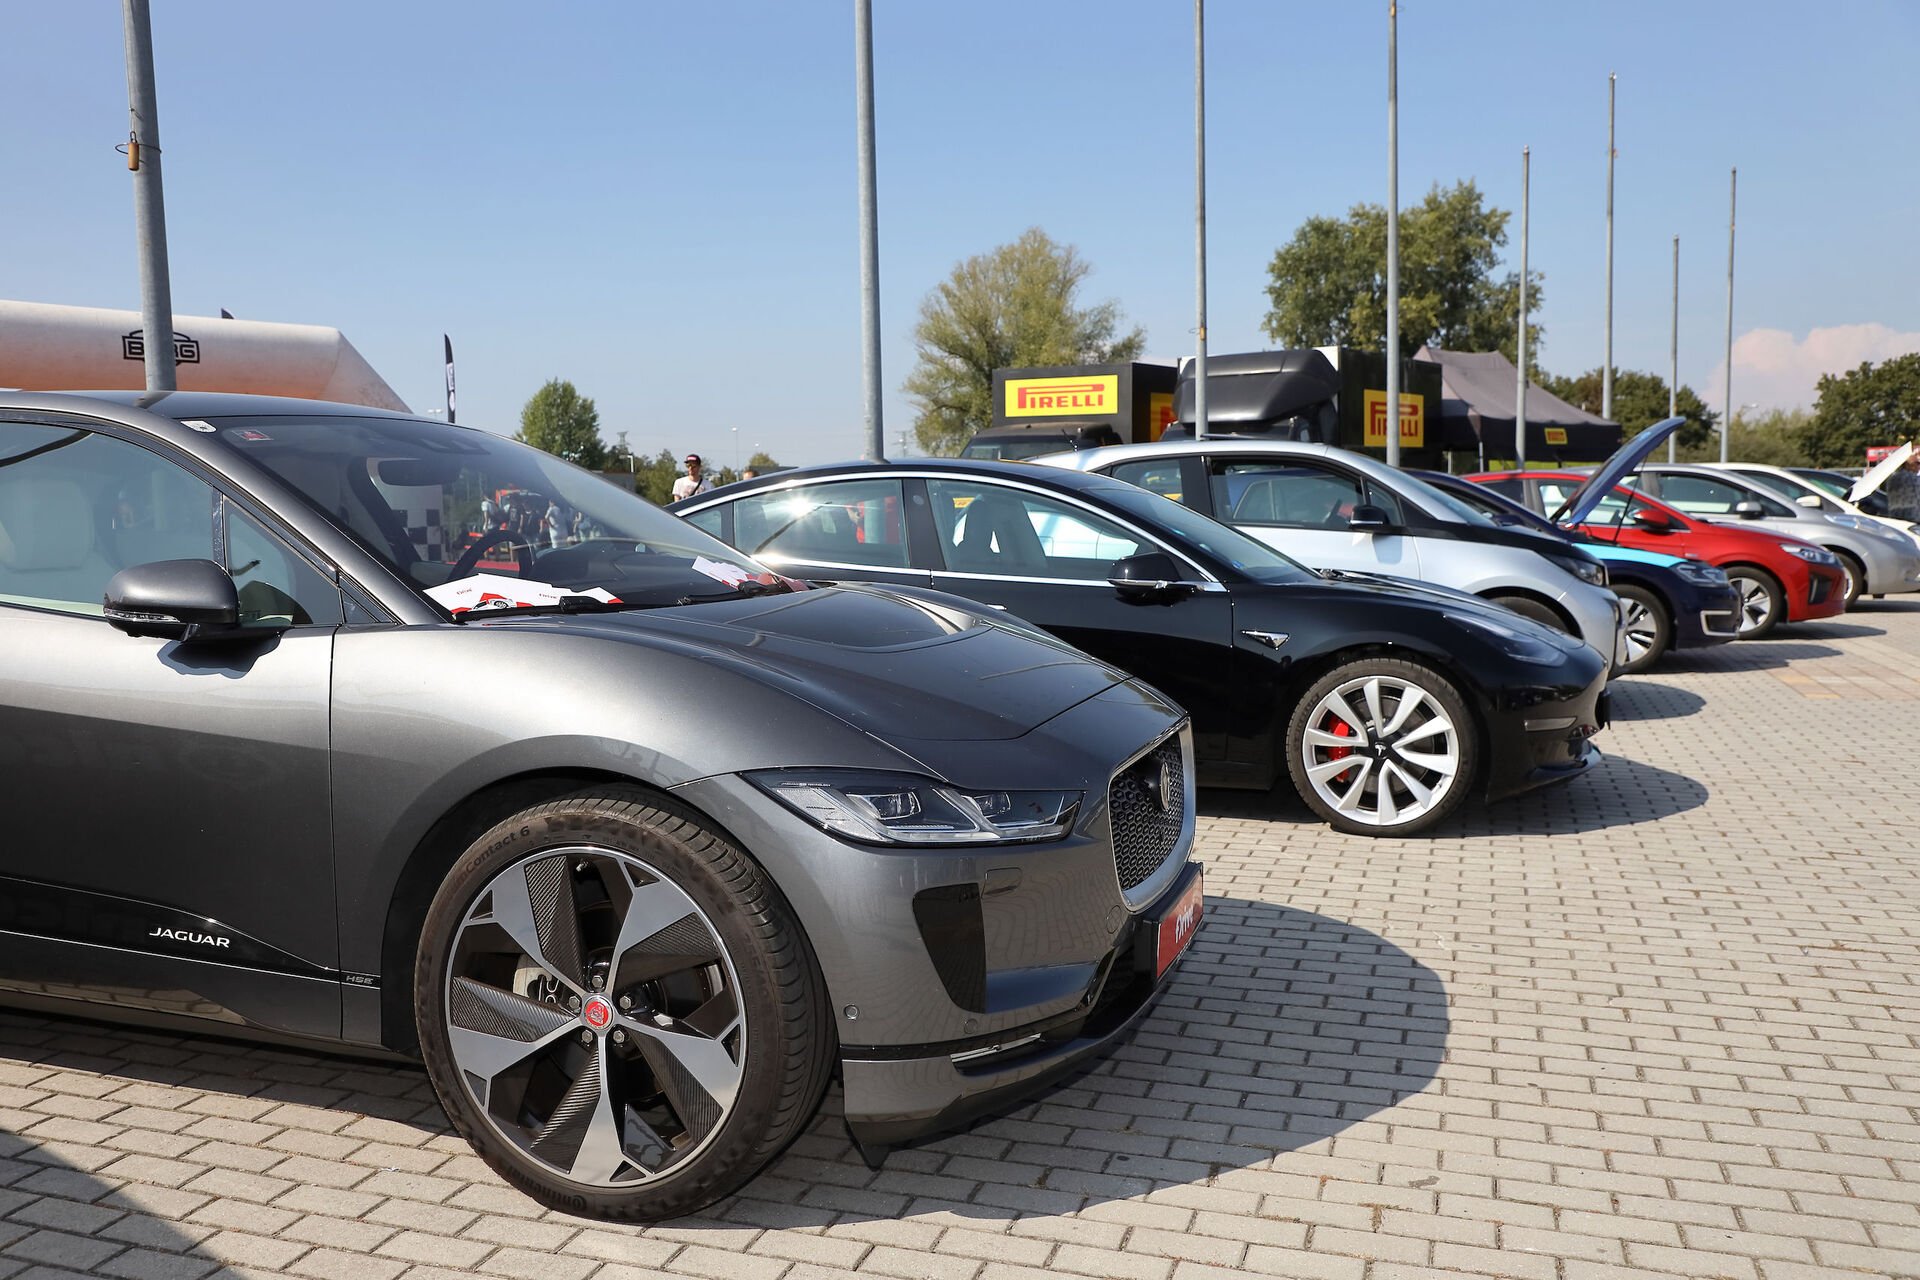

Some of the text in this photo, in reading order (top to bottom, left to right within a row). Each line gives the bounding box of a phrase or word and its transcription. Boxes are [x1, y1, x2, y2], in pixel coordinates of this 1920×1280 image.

[127, 340, 196, 359] BG
[1017, 383, 1105, 409] PIRELLI
[1370, 401, 1419, 437] PILLI
[148, 927, 231, 949] JAGUAR
[345, 975, 374, 985] HSE
